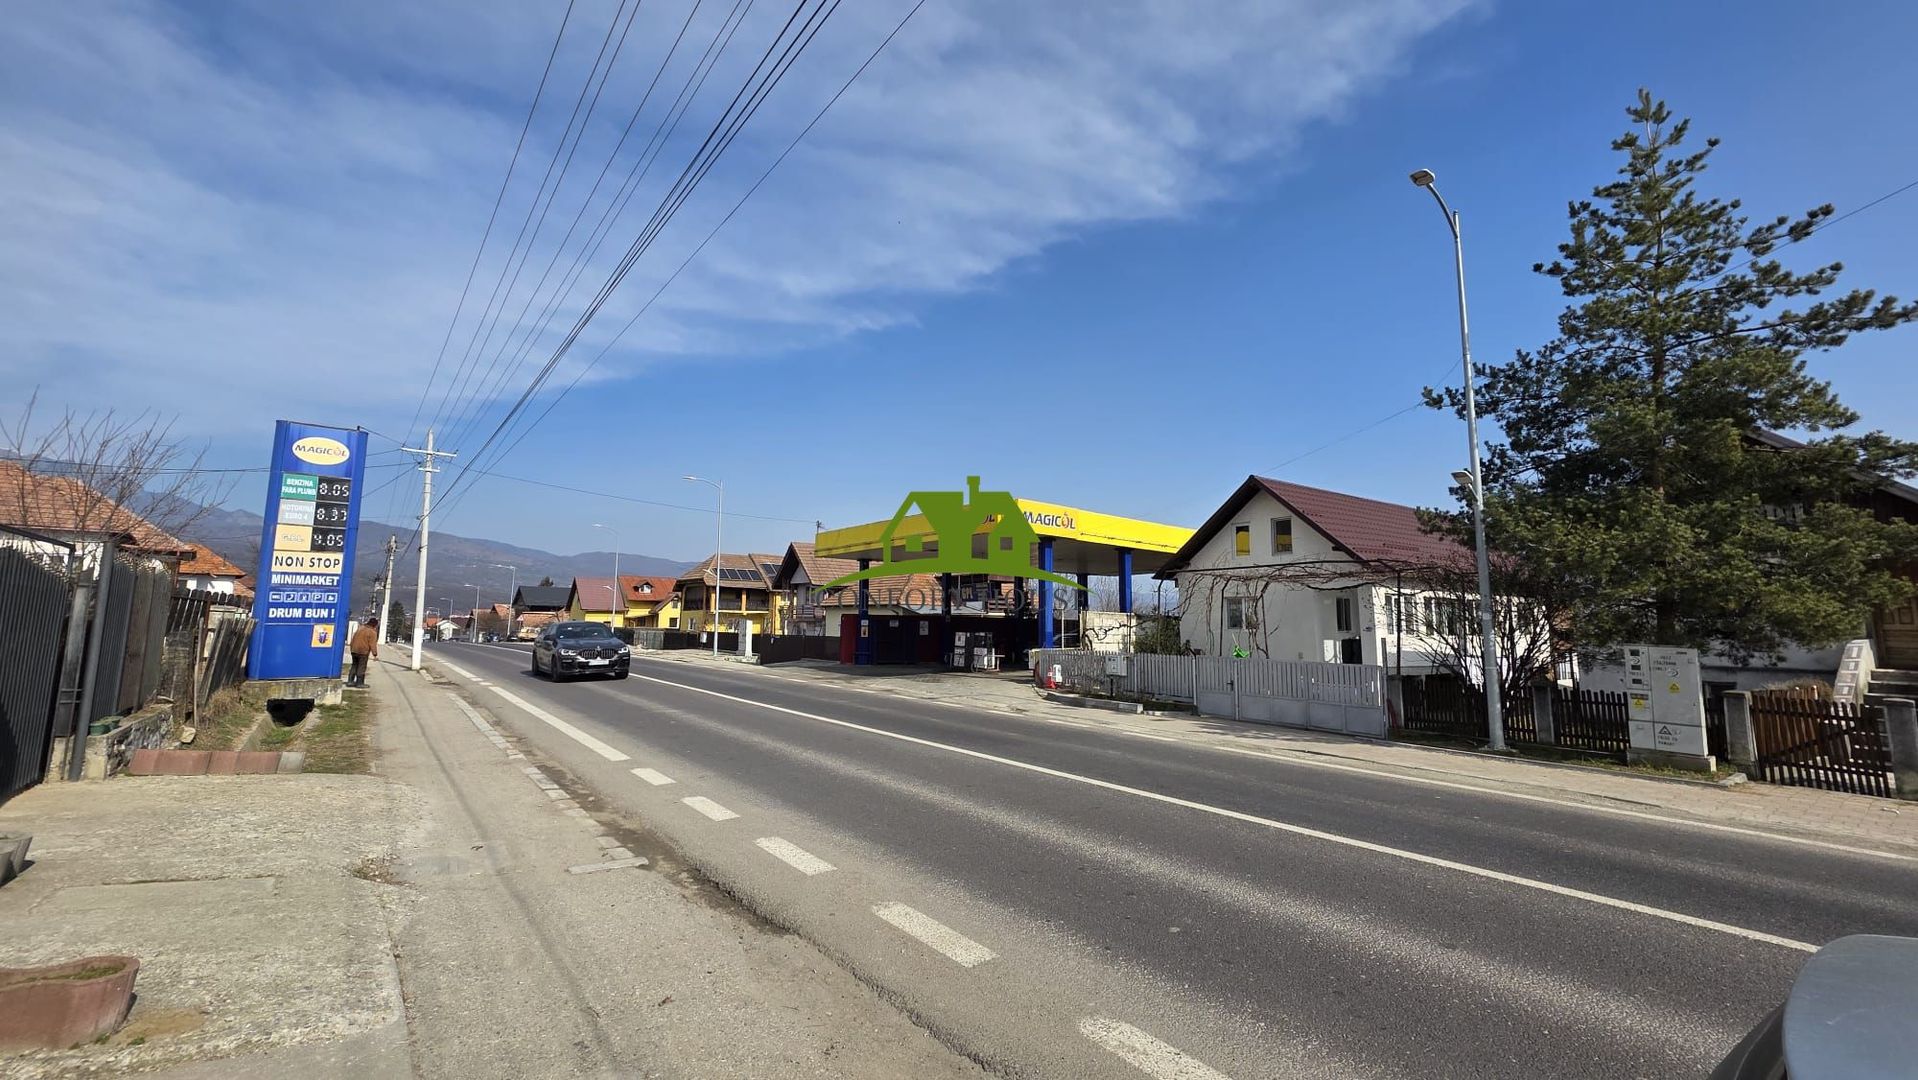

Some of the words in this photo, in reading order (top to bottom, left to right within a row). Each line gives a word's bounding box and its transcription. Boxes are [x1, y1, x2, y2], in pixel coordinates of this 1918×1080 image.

[294, 444, 347, 457] MAGICOL
[319, 483, 349, 496] 8.05
[274, 556, 304, 567] NON
[309, 557, 340, 568] STOP
[271, 574, 339, 586] MINIMARKET
[268, 607, 302, 618] DRUM
[305, 608, 328, 619] BUN
